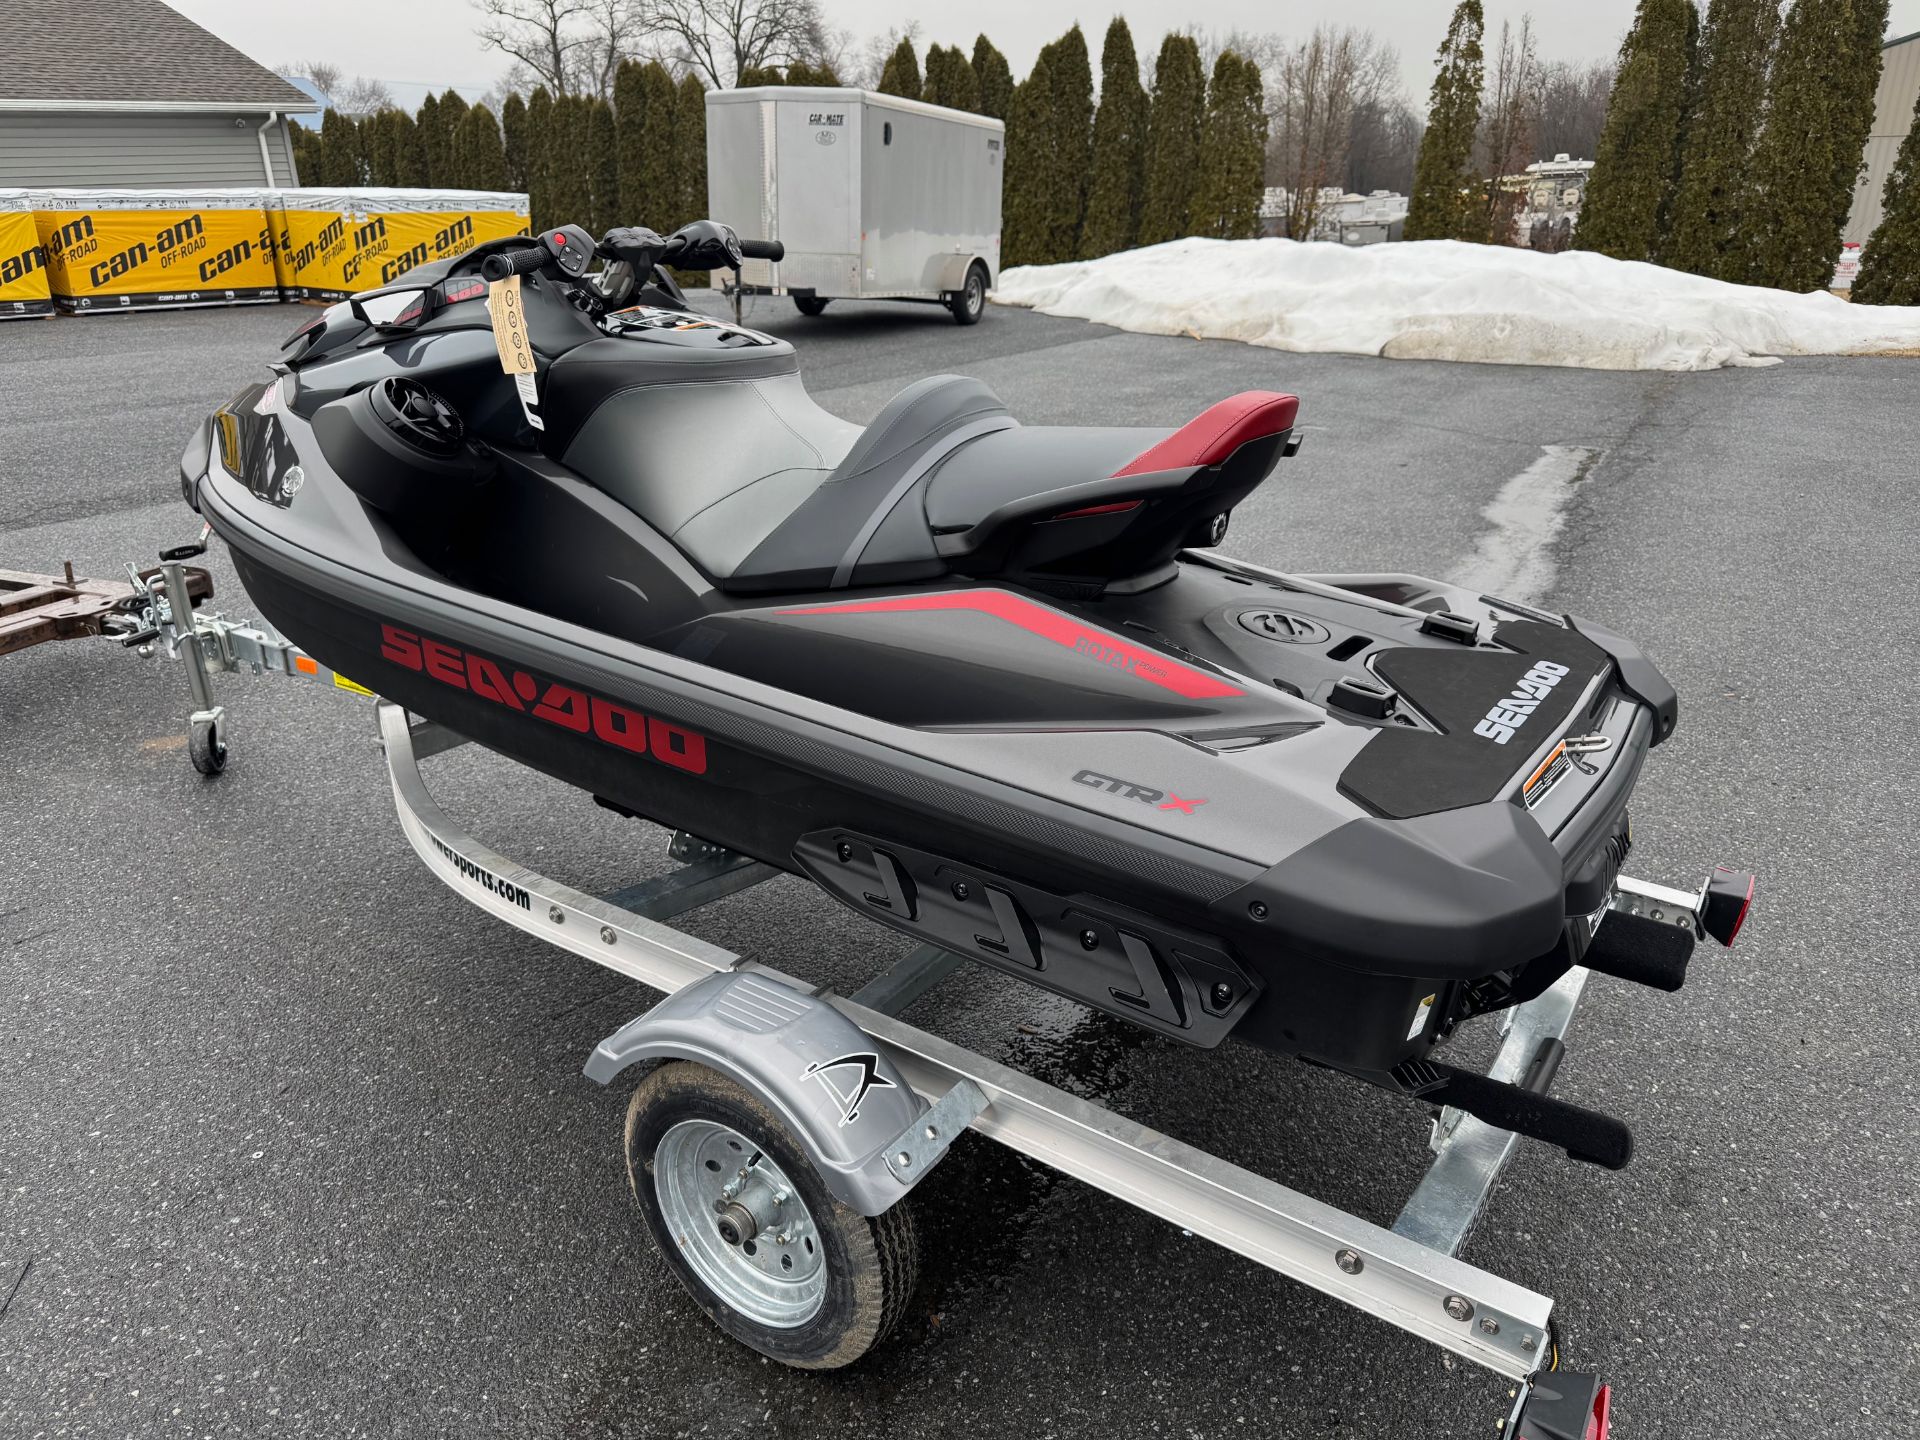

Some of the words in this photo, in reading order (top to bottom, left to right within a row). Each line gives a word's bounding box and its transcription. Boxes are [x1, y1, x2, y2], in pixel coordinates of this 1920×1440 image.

[90, 214, 203, 288] can-am
[161, 235, 207, 269] OFF-ROAD
[382, 215, 473, 284] can-am
[1073, 636, 1138, 676] ROTAX
